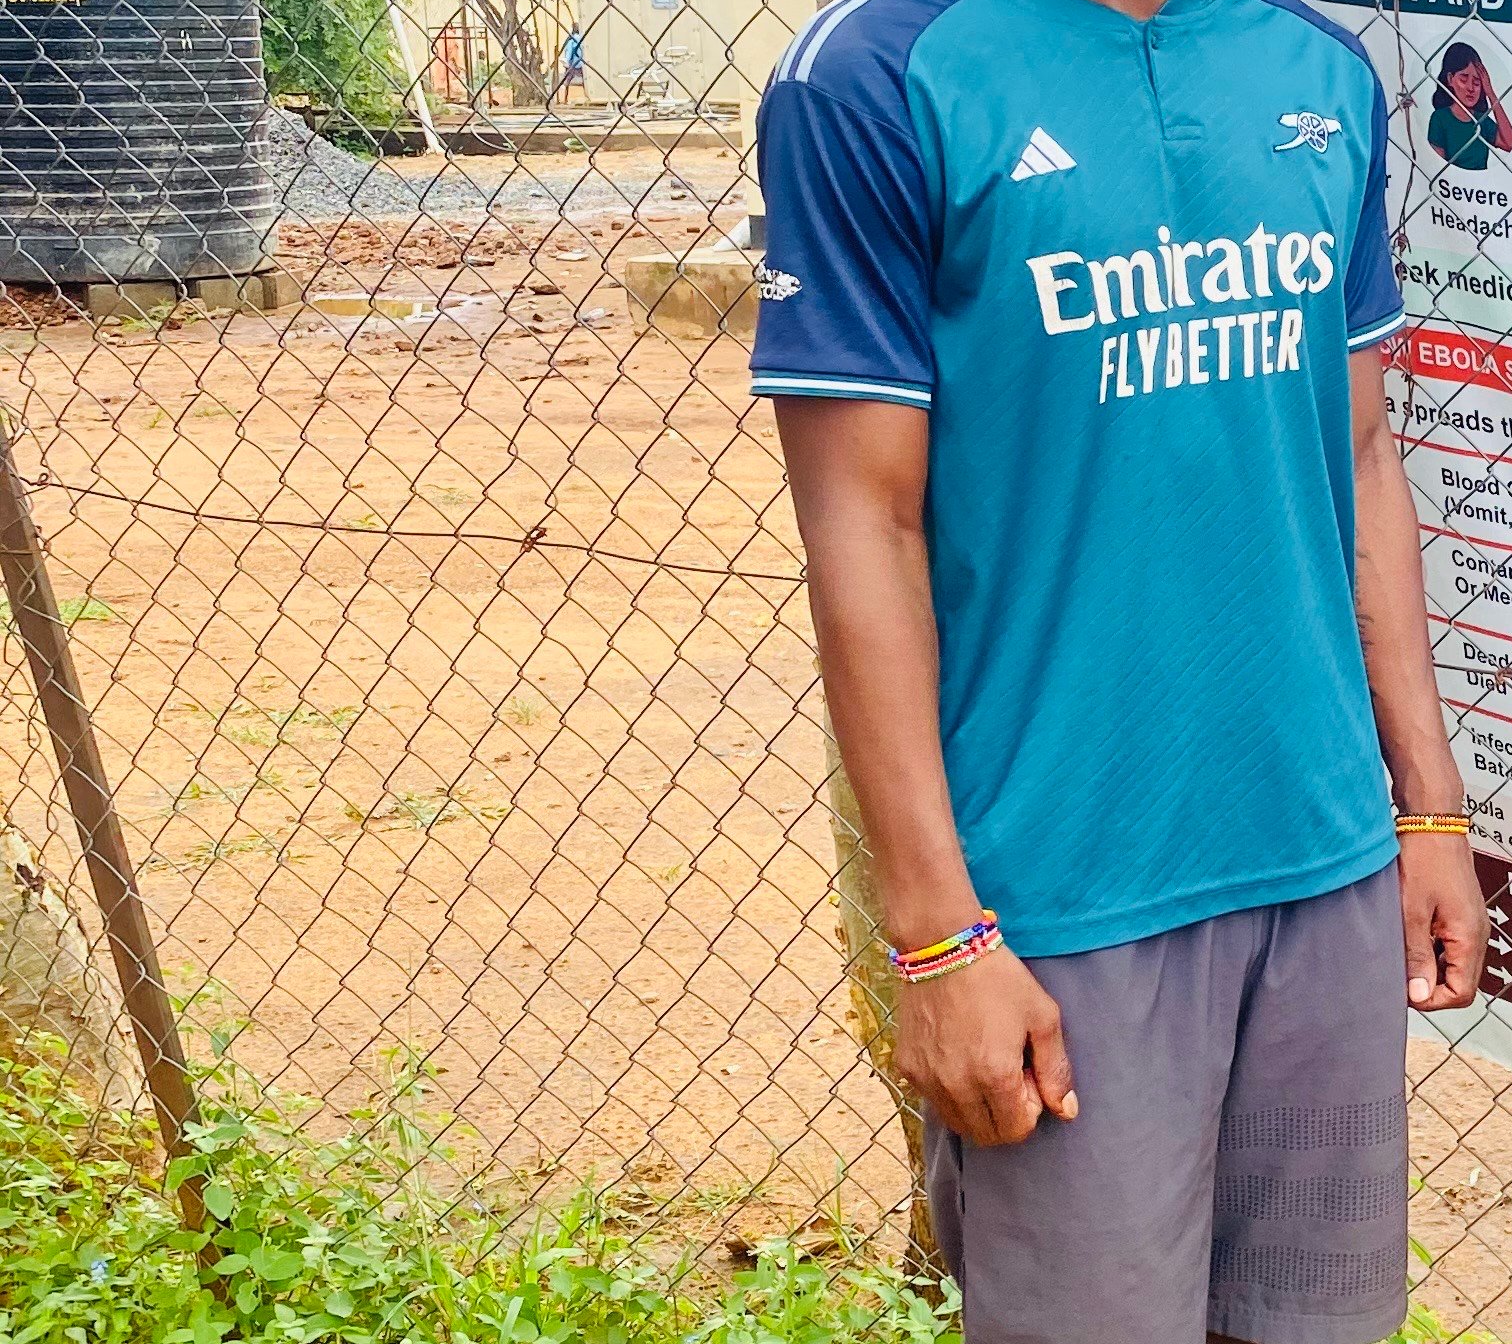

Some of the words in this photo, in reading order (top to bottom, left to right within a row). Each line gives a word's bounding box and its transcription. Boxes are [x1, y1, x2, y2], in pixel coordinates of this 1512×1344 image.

[1438, 180, 1509, 207] Severe
[1026, 222, 1334, 335] Emirates
[1099, 308, 1302, 403] FLYBETTER
[1419, 342, 1496, 375] EBOLA
[1442, 469, 1500, 498] Blood
